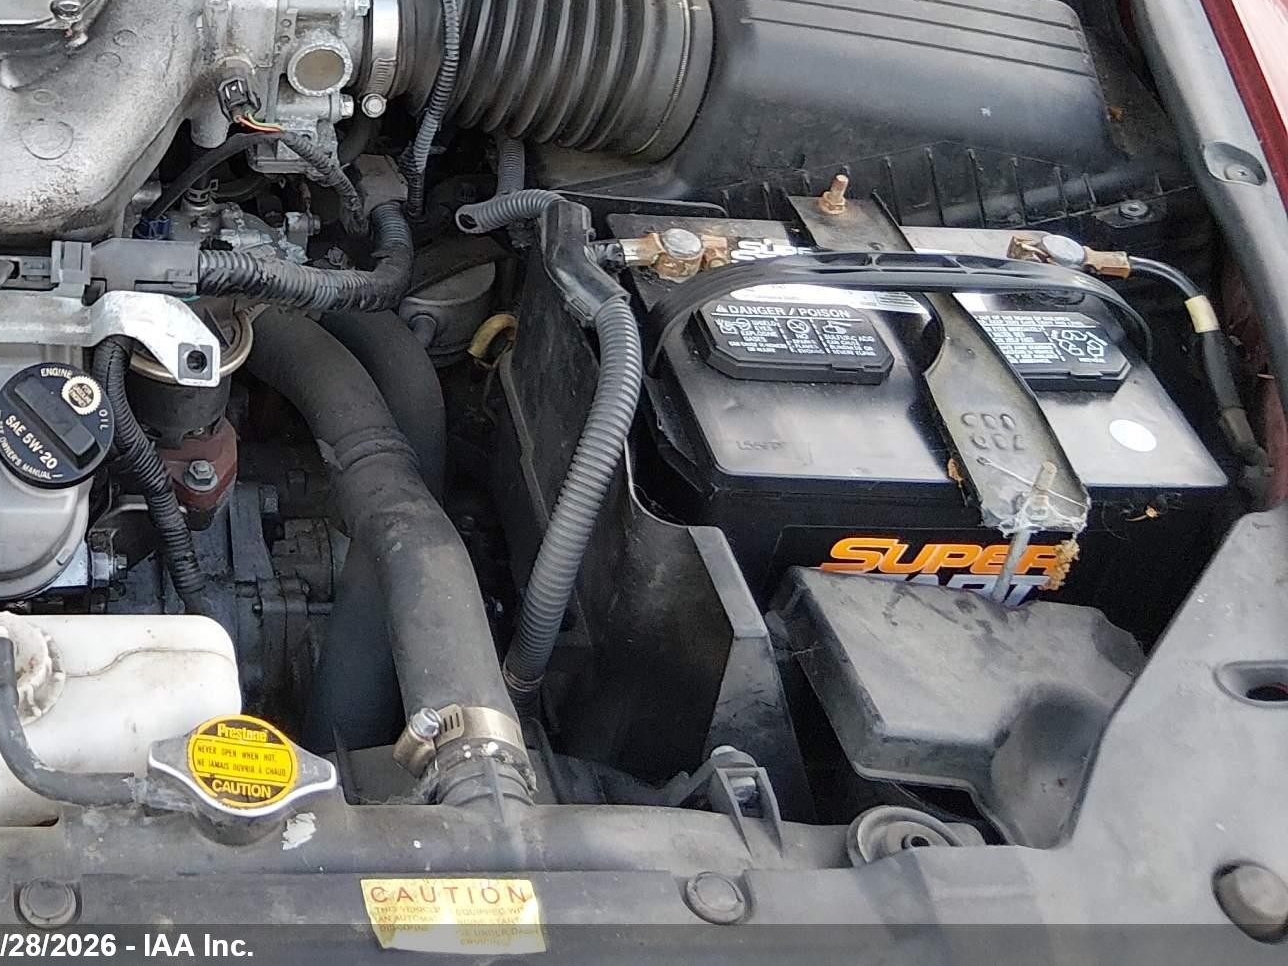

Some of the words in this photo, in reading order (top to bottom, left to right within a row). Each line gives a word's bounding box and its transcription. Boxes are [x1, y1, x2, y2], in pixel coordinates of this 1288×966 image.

[727, 304, 785, 316] DANGER
[800, 307, 851, 319] POISON
[40, 367, 73, 379] ENGINE
[98, 408, 110, 430] OIL
[5, 415, 27, 437] SAE
[22, 432, 59, 470] 5W-20
[21, 463, 53, 480] MANUAL
[821, 537, 1060, 575] SUPER
[217, 723, 269, 743] Prestone
[197, 745, 217, 755] NEVER
[221, 748, 237, 758] OPEN
[241, 751, 259, 760] WHEN
[211, 778, 272, 799] CAUTION
[370, 886, 528, 905] CAUTION
